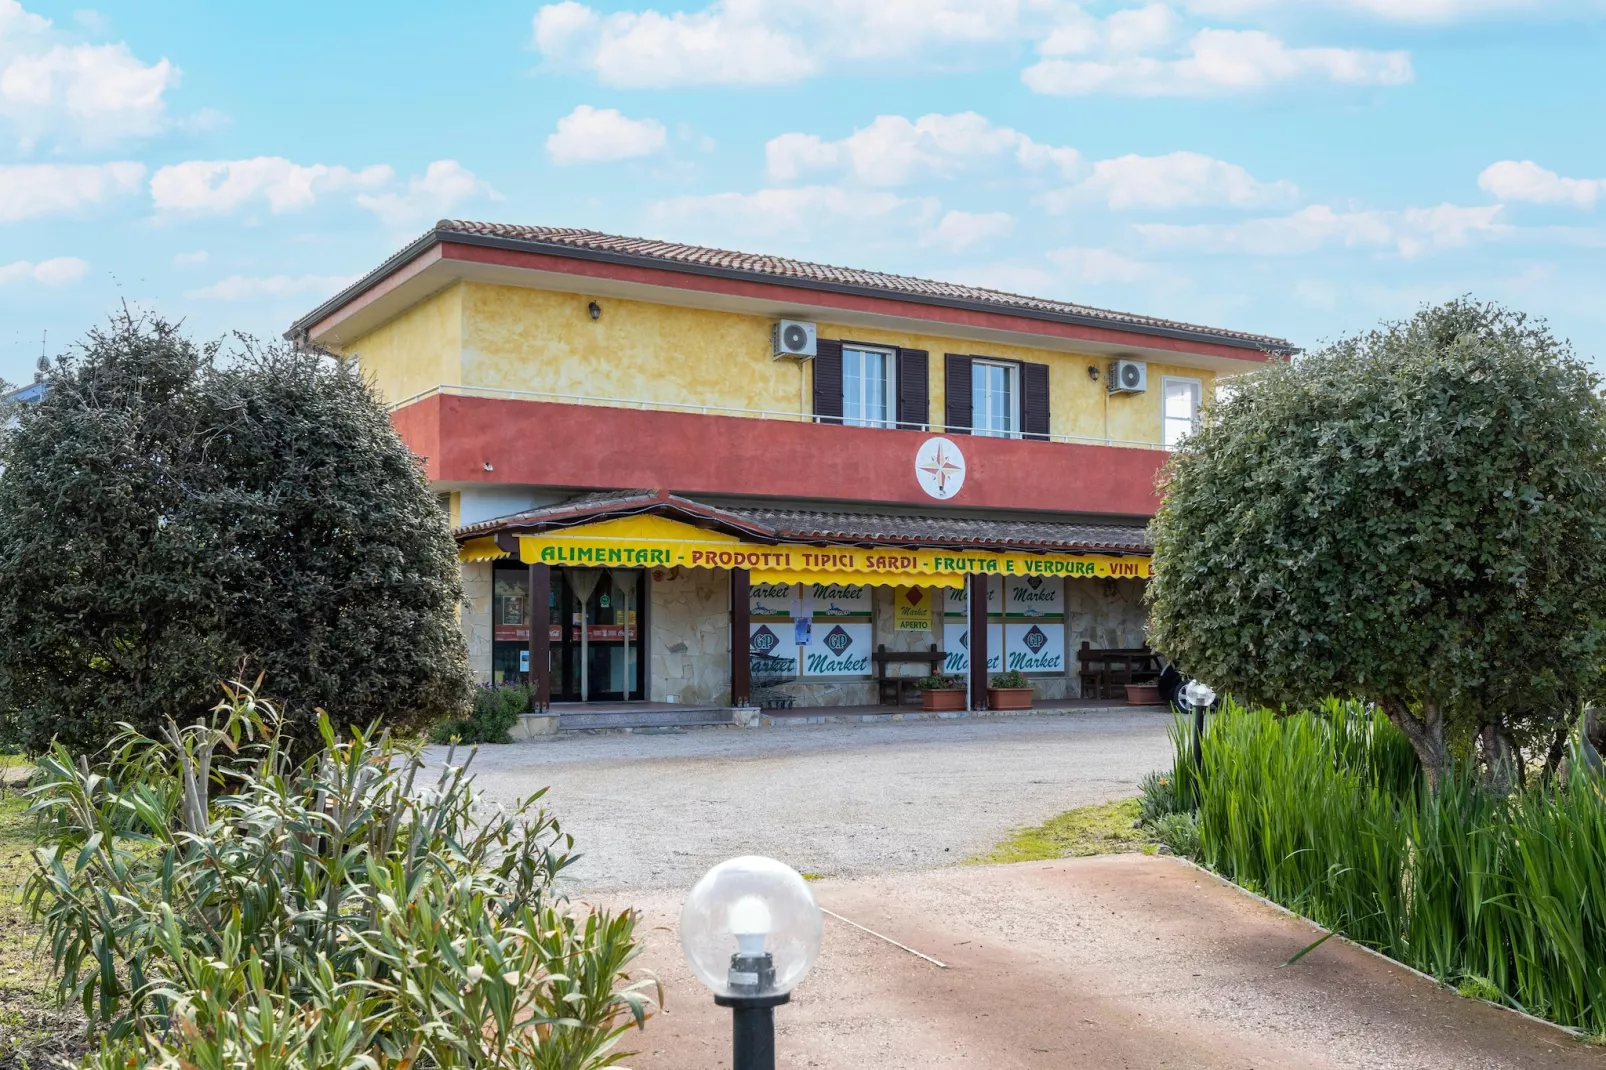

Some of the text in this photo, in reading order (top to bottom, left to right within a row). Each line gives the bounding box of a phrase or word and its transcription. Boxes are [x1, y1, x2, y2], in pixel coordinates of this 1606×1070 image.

[540, 546, 670, 563] ALIMENTARI
[692, 550, 790, 567] PRODOTTI
[802, 553, 854, 567] TIPICI
[866, 555, 917, 570] SARDI
[934, 557, 998, 571] FRUTTA
[1006, 559, 1014, 571] E
[1024, 559, 1095, 575] VERDURA
[1109, 562, 1139, 576] VINI
[750, 585, 789, 598] arket
[812, 582, 862, 600] Market
[1012, 586, 1056, 602] Market
[900, 606, 927, 616] Market
[900, 621, 928, 629] APERTO
[751, 653, 796, 673] arket
[807, 652, 868, 674] Market
[1008, 651, 1061, 668] Market
